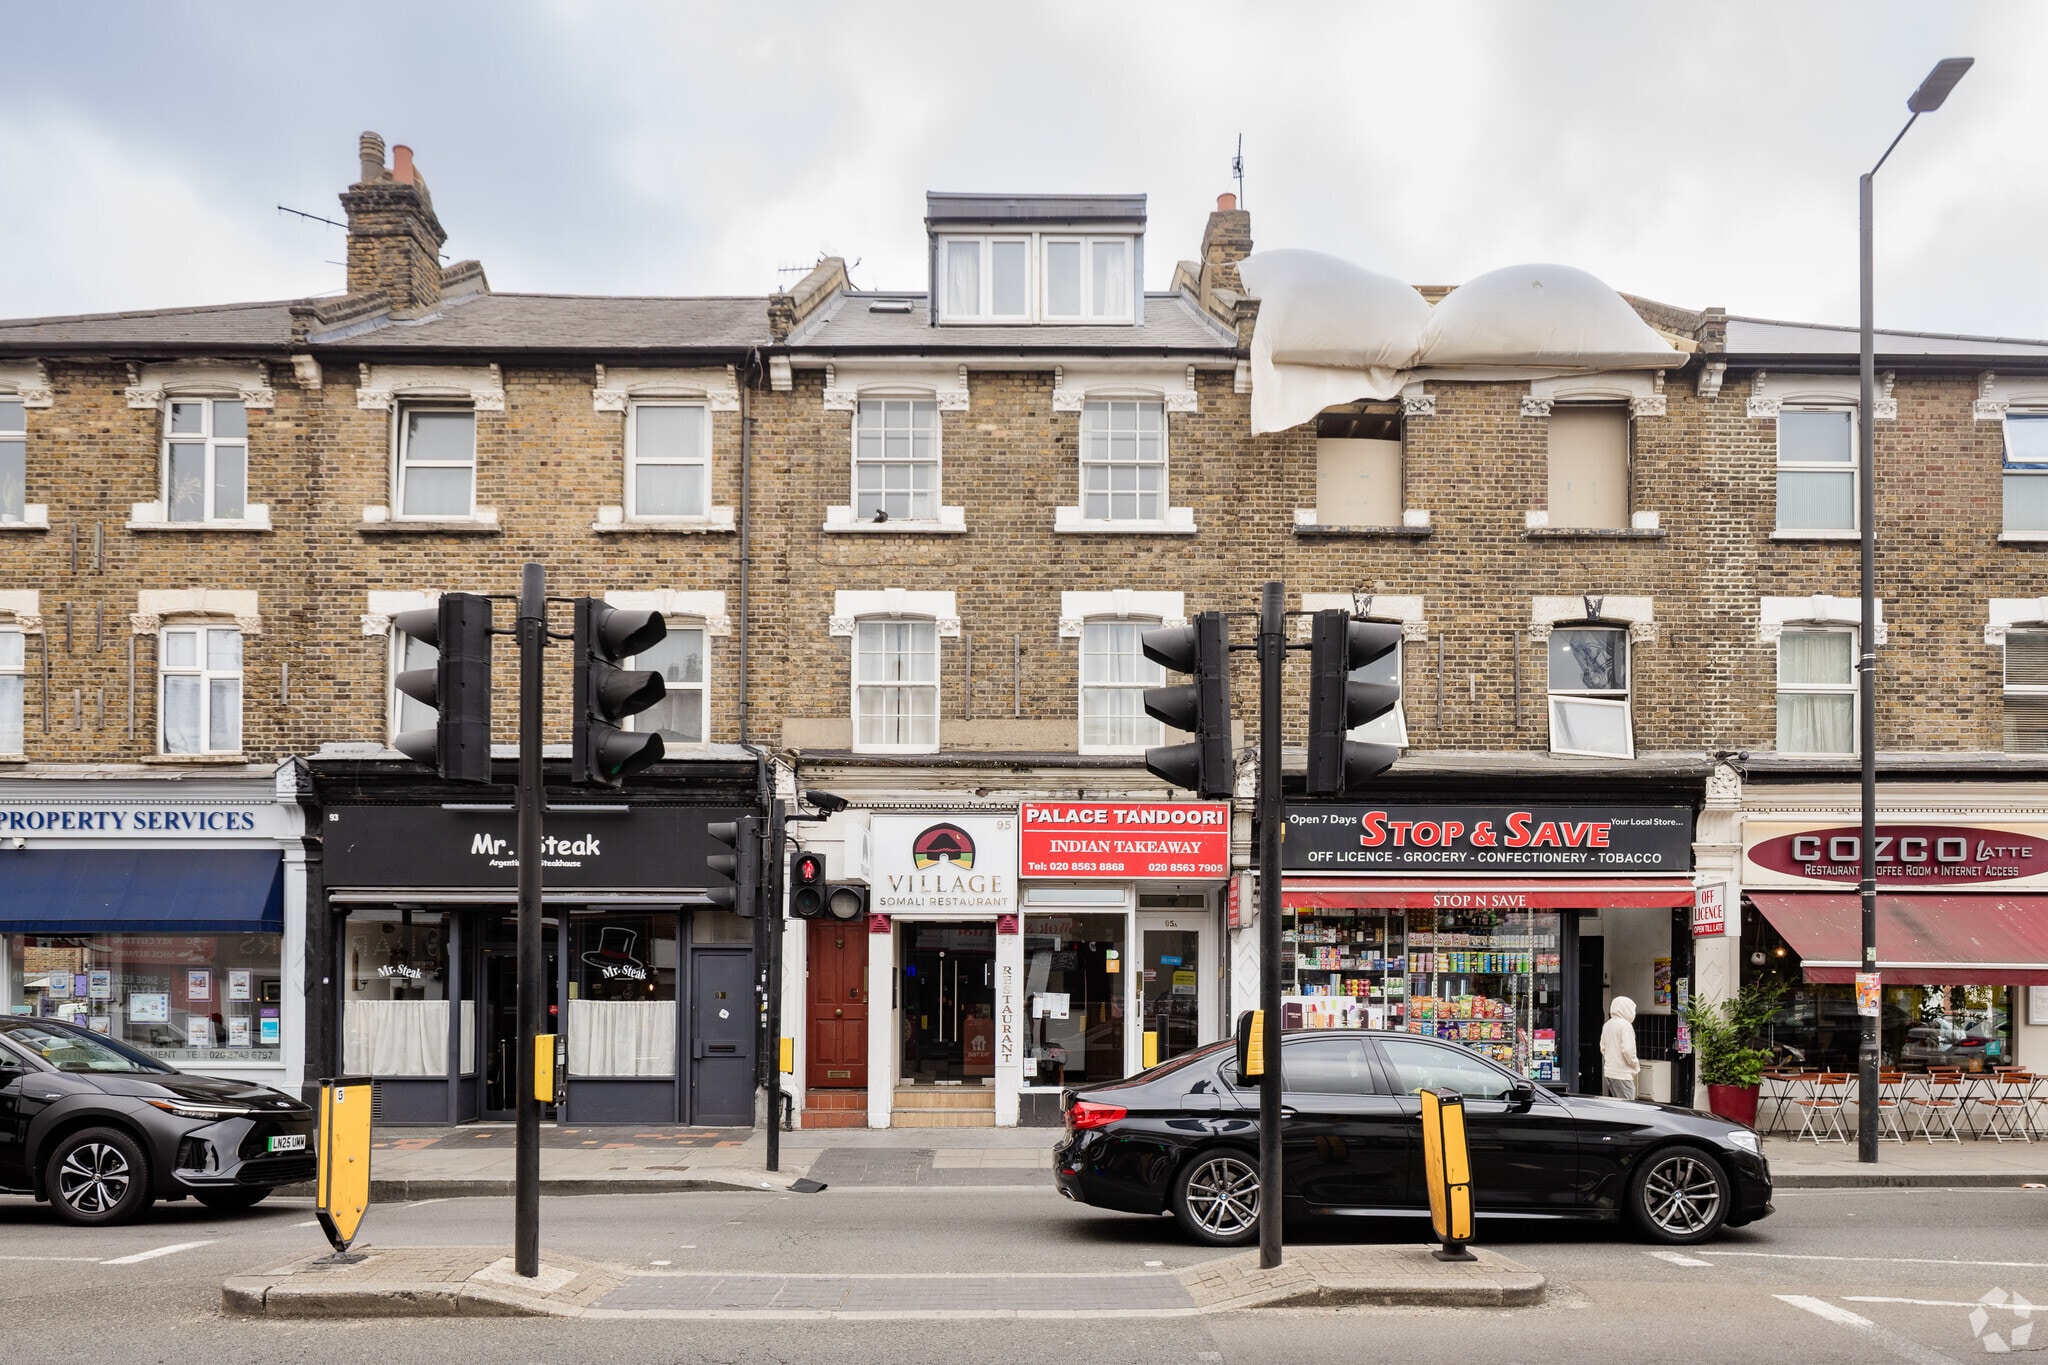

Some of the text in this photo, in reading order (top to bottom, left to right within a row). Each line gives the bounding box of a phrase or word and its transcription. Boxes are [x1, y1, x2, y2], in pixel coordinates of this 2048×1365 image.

[0, 811, 255, 830] PROPERTY SERVICES
[329, 813, 339, 821] 93
[1026, 809, 1224, 825] PALACE TANDOORI
[1290, 814, 1357, 826] Open 7 Days
[1611, 818, 1683, 826] Your Local Store...
[997, 820, 1011, 829] 95
[1360, 811, 1611, 848] STOP & SAVE
[471, 833, 515, 856] Mr.
[1050, 840, 1202, 854] INDIAN TAKEAWAY
[1792, 837, 1967, 862] COZCO
[1308, 852, 1333, 862] OFF
[1337, 852, 1393, 863] LICENCE
[1403, 852, 1467, 863] GROCERY
[1478, 852, 1588, 863] CONFECTIONERY
[1598, 853, 1662, 863] TOBACCO
[1028, 862, 1223, 873] Tel: 020 8563 8868 020 8563 7905
[1805, 864, 2019, 877] RESTAURANT OFFEE ROOM INTERNET ACCESS
[888, 875, 1002, 893] VILLAGE
[880, 897, 1008, 906] SOMALI RESTAURANT
[1433, 895, 1526, 907] STOP N SAVE
[1702, 890, 1714, 904] OFF
[1694, 905, 1722, 921] LICENCE
[1165, 920, 1177, 928] 95A
[1713, 923, 1724, 931] LATE
[377, 964, 422, 978] Mr. Steak
[602, 965, 647, 979] Mr. Steak
[1002, 965, 1013, 1063] RESTAURANT
[186, 1052, 207, 1060] TEL:
[210, 1052, 225, 1060] 020
[228, 1052, 248, 1060] 3748
[252, 1052, 273, 1061] 6797
[273, 1137, 291, 1149] LN25
